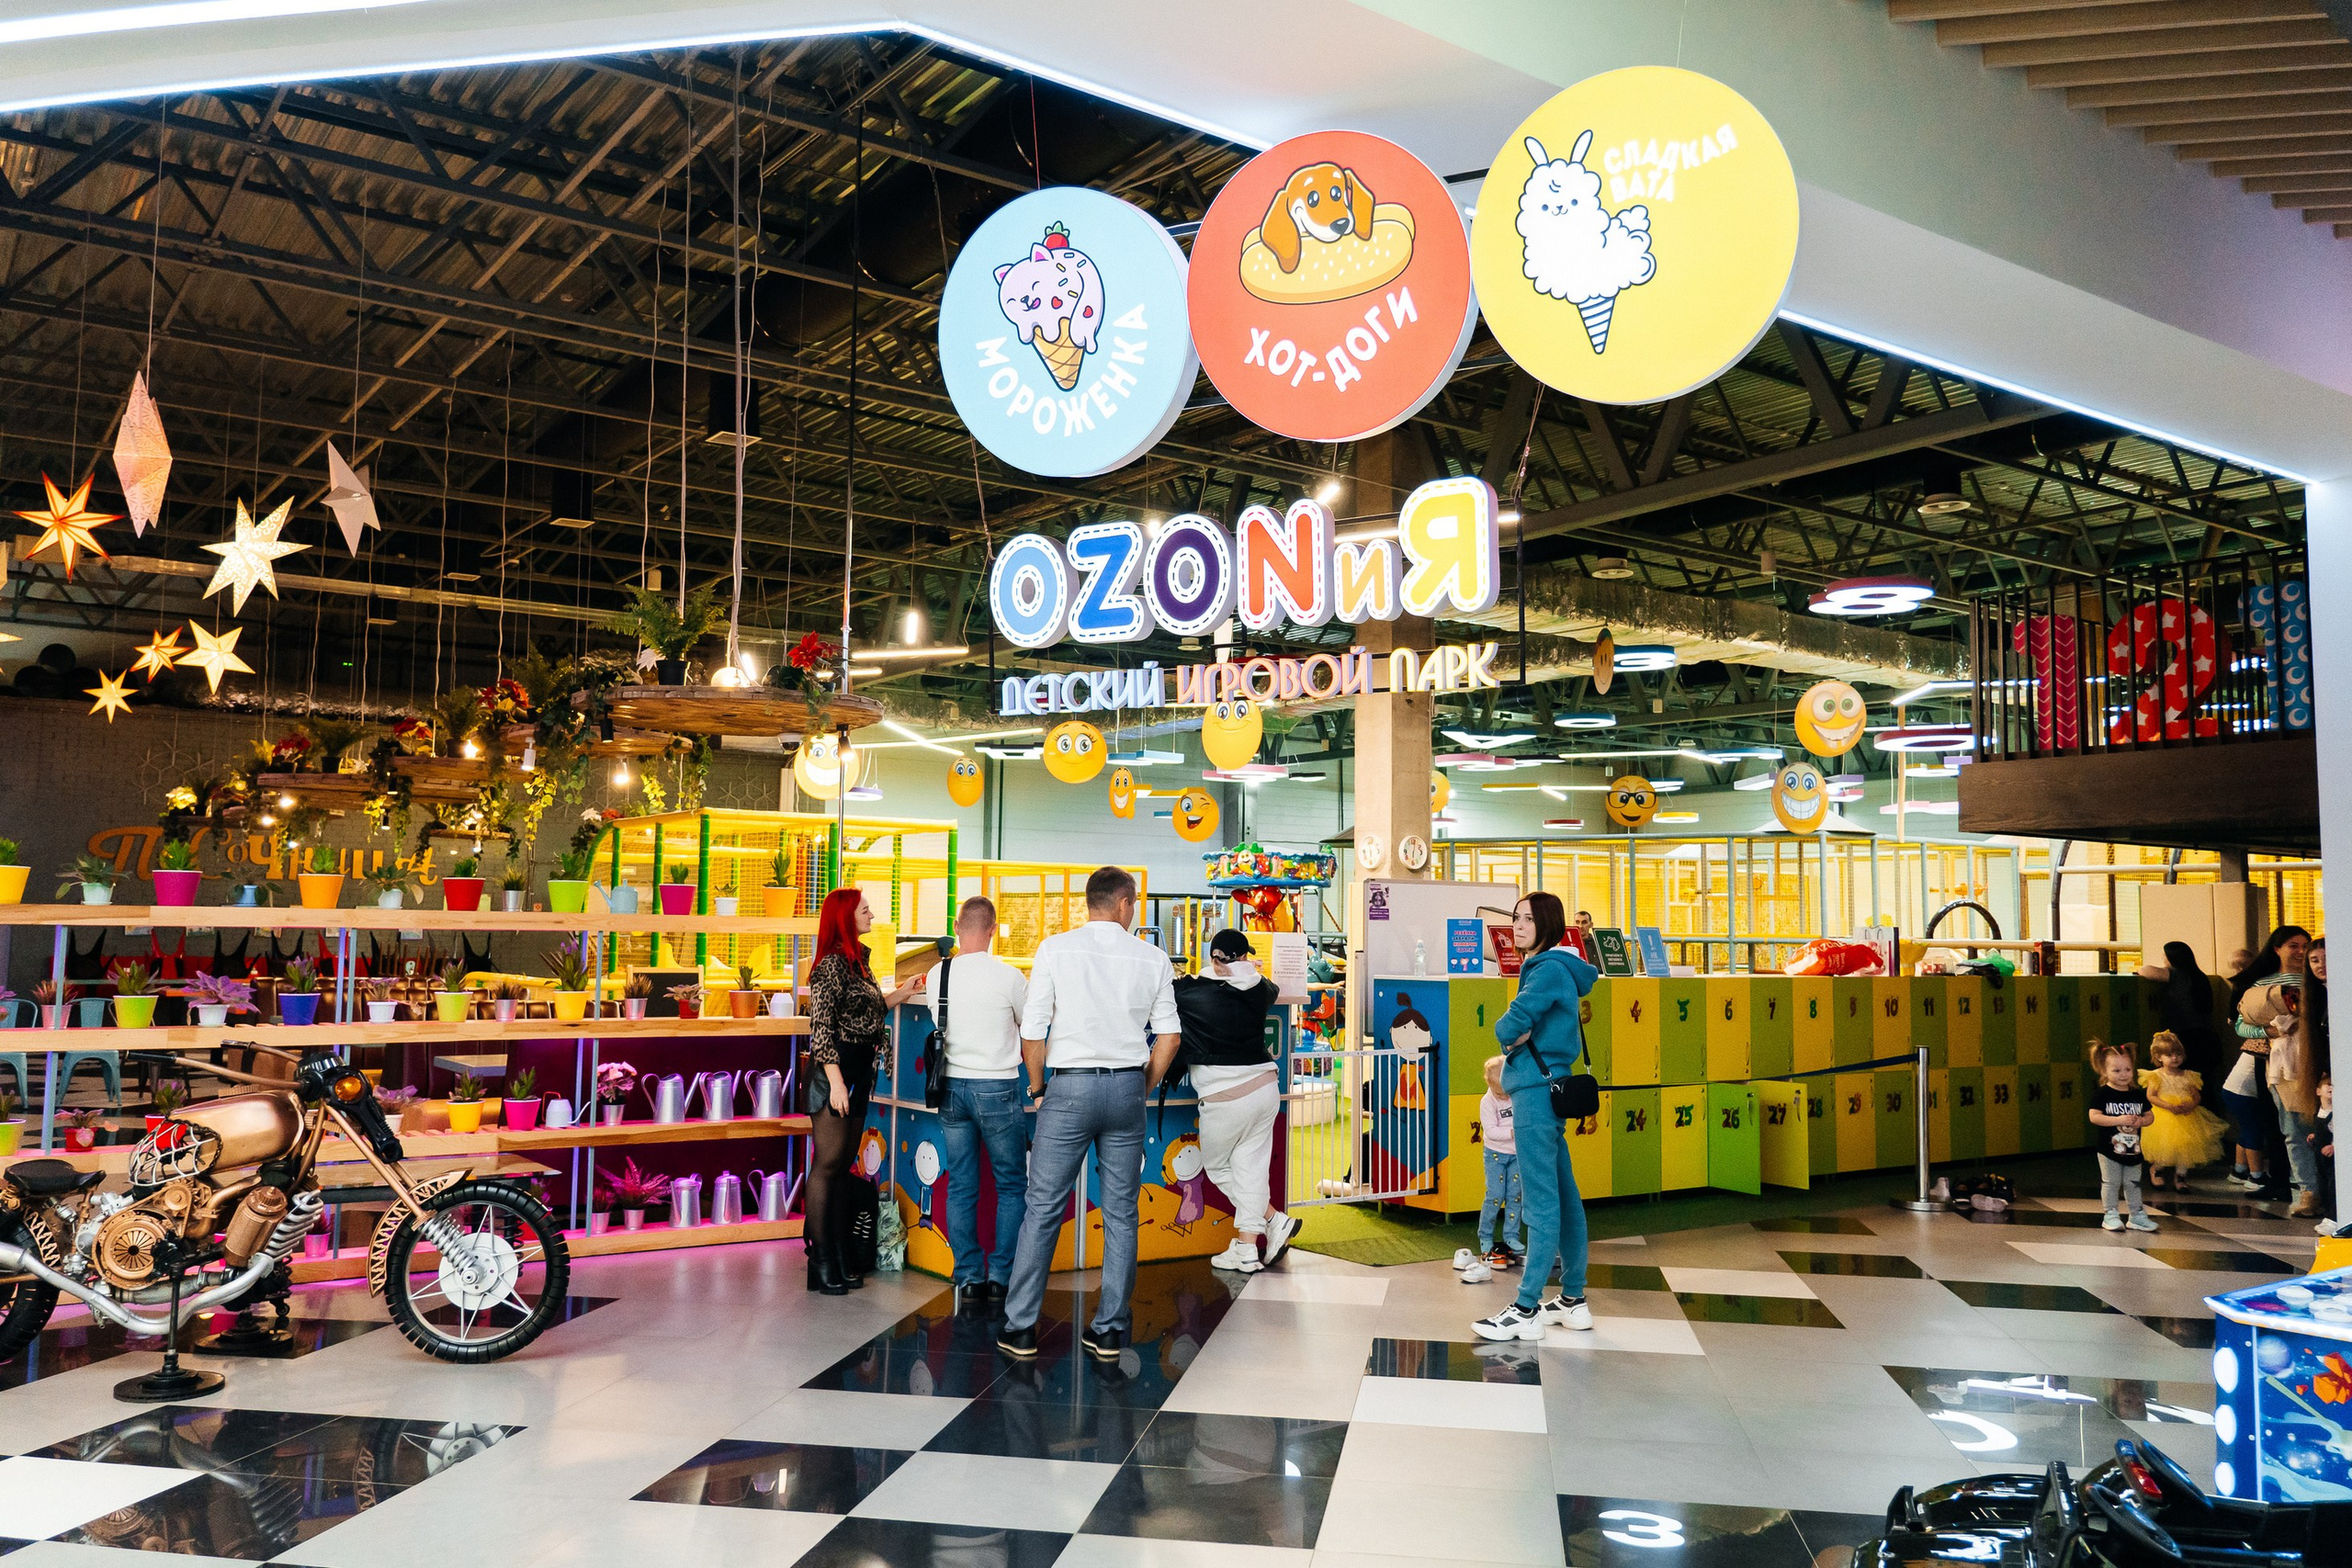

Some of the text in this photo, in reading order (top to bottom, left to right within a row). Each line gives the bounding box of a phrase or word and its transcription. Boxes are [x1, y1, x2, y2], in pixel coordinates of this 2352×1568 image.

[1603, 123, 1738, 175] СЛАДКАЯ
[1610, 170, 1675, 203] ВАТА
[1244, 286, 1418, 392] ХОТ-ДОГИ
[976, 303, 1148, 437] МОРОЖЕНКА
[999, 642, 1500, 716] ДЕТСКИЙ ИГРОВОЙ ПАРК
[1476, 1003, 1485, 1027] 1
[1581, 999, 1592, 1025] 3
[1630, 999, 1642, 1022] 4
[1677, 998, 1690, 1022] 5
[1724, 998, 1733, 1021] 6
[1769, 997, 1776, 1020] 7
[1809, 997, 1817, 1019] 8
[1849, 996, 1858, 1018] 9
[1884, 996, 1899, 1018] 10
[1924, 997, 1935, 1016] 11
[1958, 997, 1971, 1015] 12
[1993, 996, 2005, 1014] 13
[2026, 994, 2038, 1014] 14
[1848, 1093, 1862, 1115] 29
[1886, 1091, 1902, 1112] 30
[1959, 1086, 1974, 1107] 32
[1994, 1084, 2009, 1105] 33
[1675, 1104, 1694, 1129] 25
[1722, 1106, 1740, 1129] 26
[1768, 1102, 1787, 1125] 27
[1807, 1096, 1824, 1118] 28
[1576, 1114, 1598, 1136] 23
[1626, 1108, 1646, 1133] 24
[1470, 1121, 1483, 1145] 2
